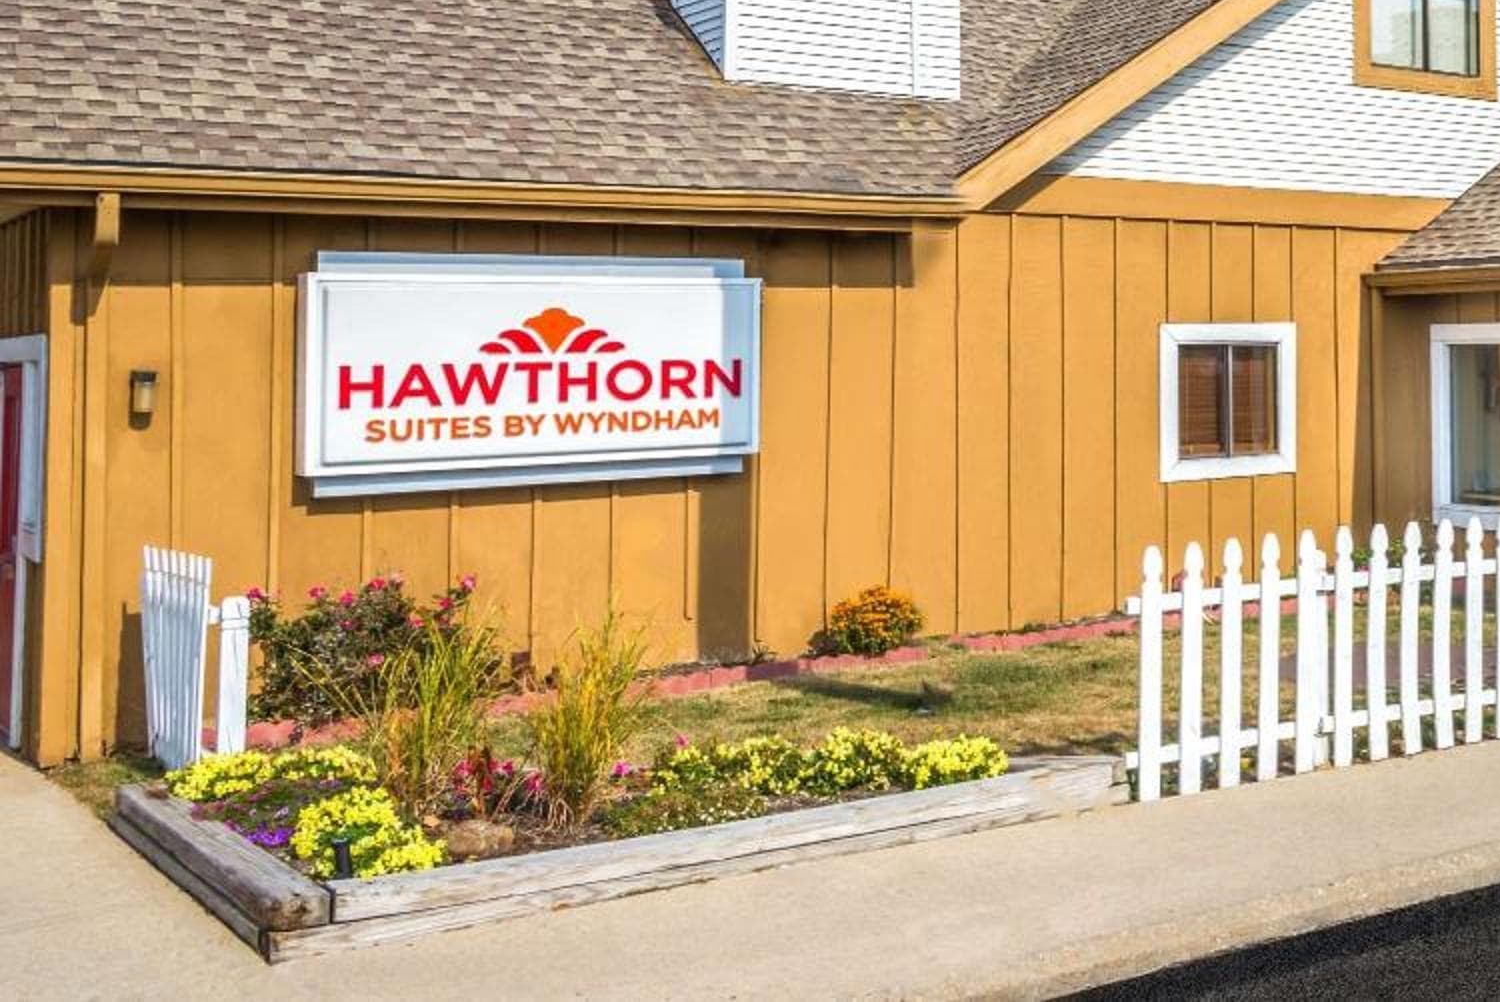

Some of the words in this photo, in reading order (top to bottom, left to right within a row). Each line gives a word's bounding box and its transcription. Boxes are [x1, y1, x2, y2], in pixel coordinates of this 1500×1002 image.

[338, 359, 743, 409] HAWTHORN
[365, 415, 492, 443] SUITES
[504, 414, 546, 438] BY
[555, 408, 720, 434] WYNDHAM
